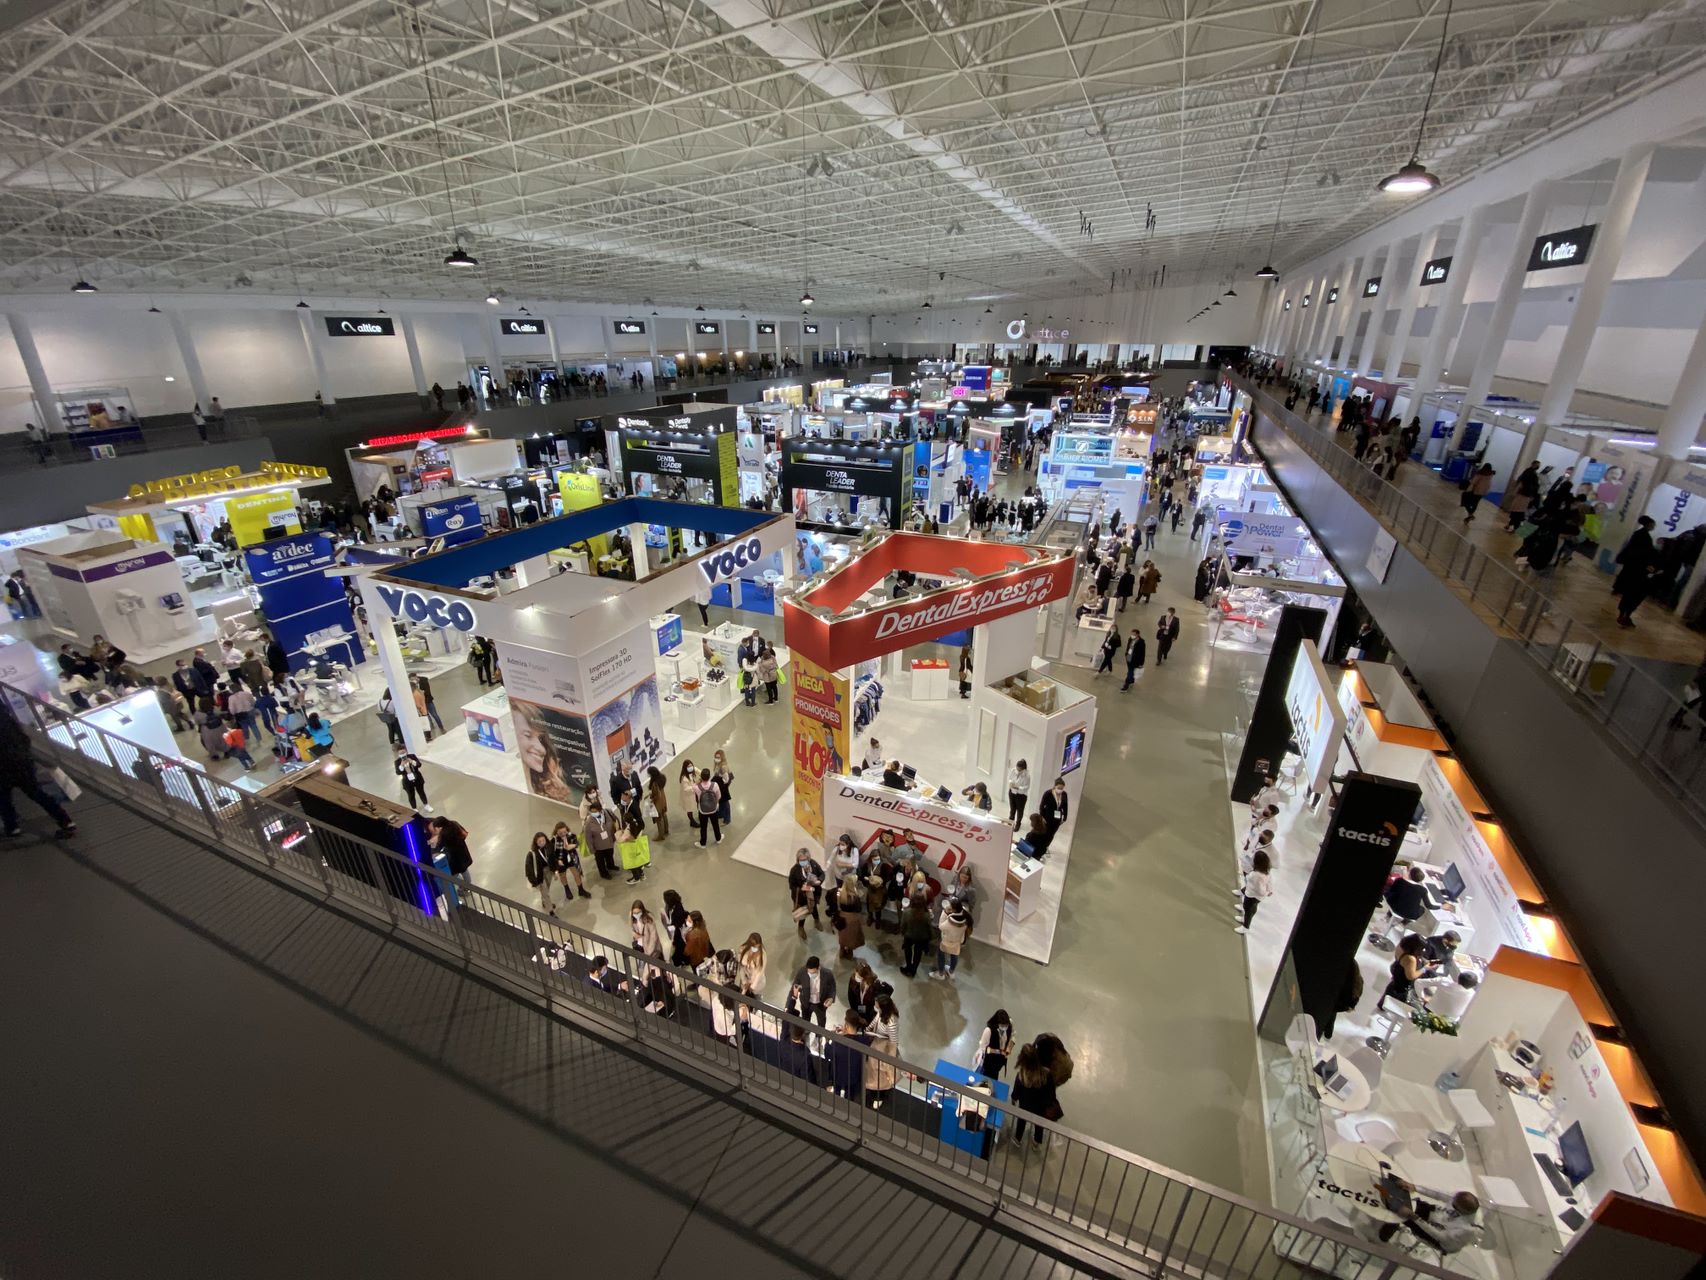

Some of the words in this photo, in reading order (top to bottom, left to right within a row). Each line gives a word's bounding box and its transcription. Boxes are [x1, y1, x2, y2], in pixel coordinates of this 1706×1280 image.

[1552, 242, 1577, 260] altice
[357, 324, 382, 333] altice
[656, 454, 675, 463] DENTA
[661, 461, 682, 469] LEADER
[826, 470, 848, 479] DENTA
[830, 478, 856, 486] LEADER
[1260, 523, 1285, 531] Dental
[700, 537, 762, 583] VOCO
[376, 585, 475, 632] VOCO
[875, 580, 1031, 639] DentalExpress
[589, 652, 619, 674] Impressora
[619, 647, 628, 658] 3D
[611, 661, 623, 673] 170
[623, 654, 633, 665] HD
[796, 674, 825, 695] MEGA
[795, 698, 840, 724] PROMOÇÕES
[794, 731, 835, 780] 40%
[839, 786, 966, 830] DentalExpress
[1338, 826, 1391, 847] tactis
[1317, 1179, 1380, 1208] tactis
